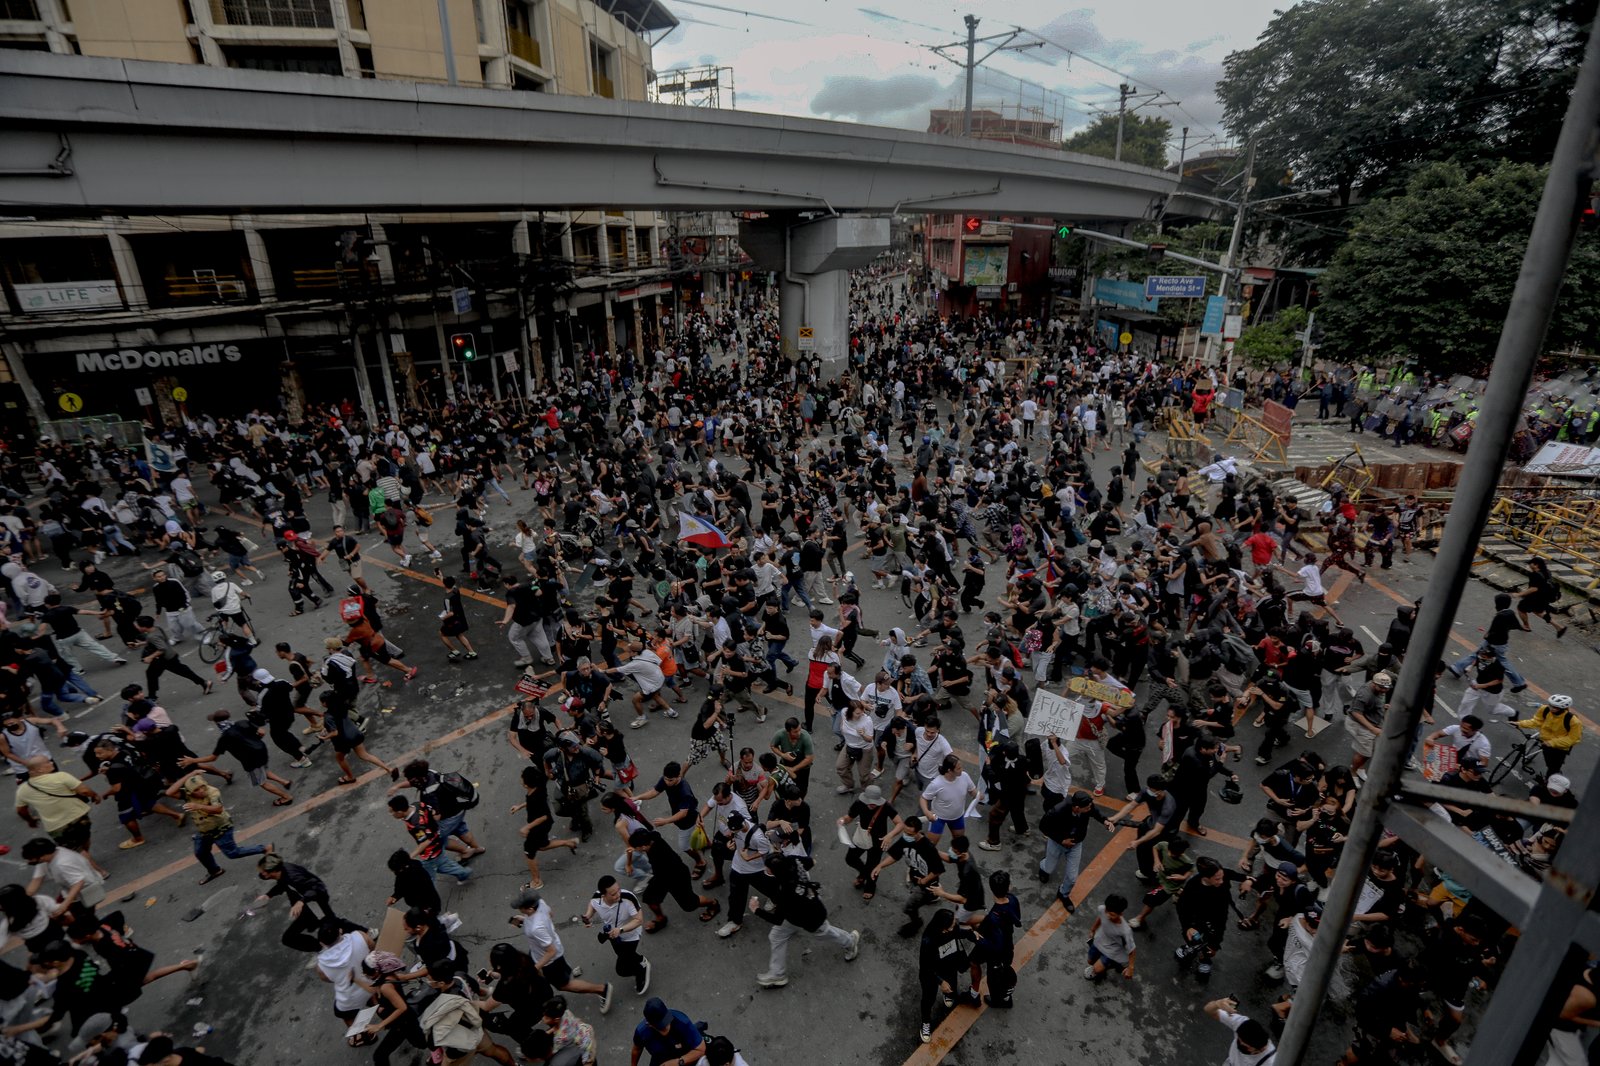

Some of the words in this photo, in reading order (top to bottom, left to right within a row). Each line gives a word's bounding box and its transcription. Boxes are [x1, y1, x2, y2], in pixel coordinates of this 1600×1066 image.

[75, 343, 242, 373] McDonald's
[1040, 696, 1078, 722] FUCK
[1048, 716, 1064, 726] THE
[1482, 828, 1504, 851] BUHAY
